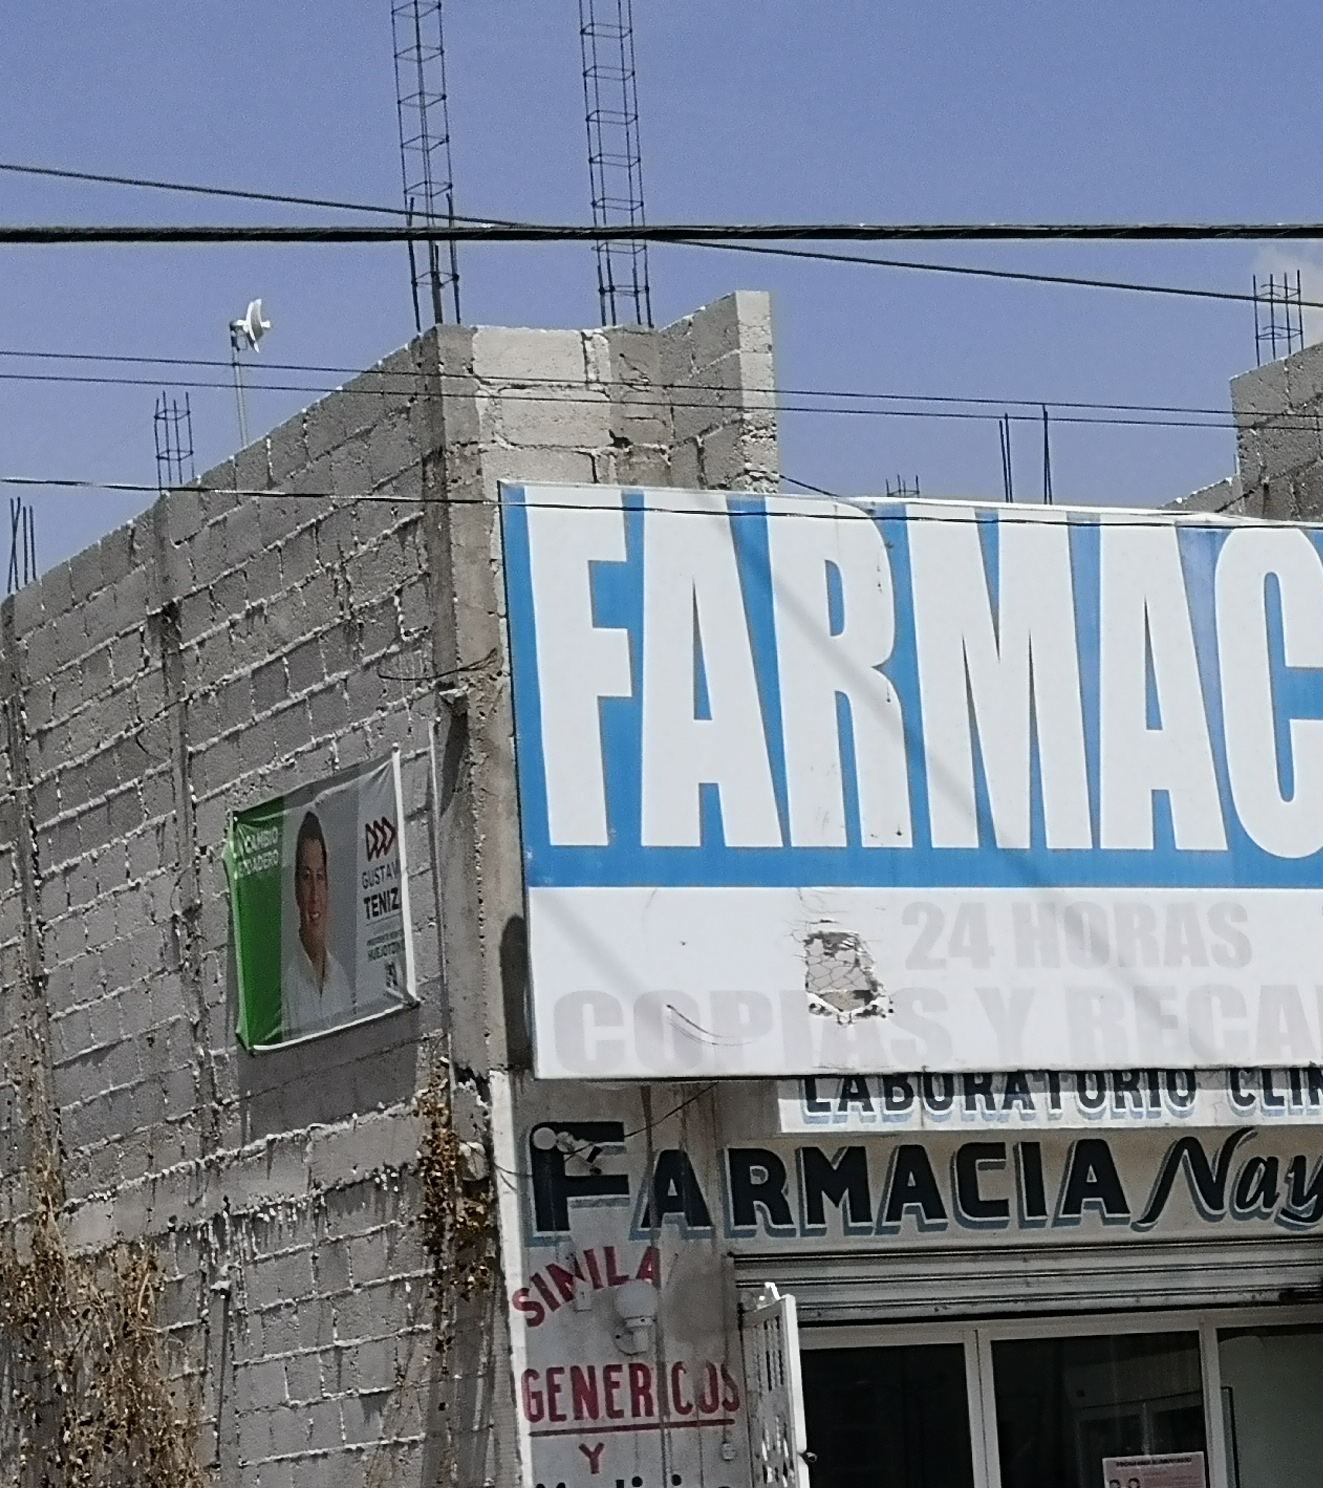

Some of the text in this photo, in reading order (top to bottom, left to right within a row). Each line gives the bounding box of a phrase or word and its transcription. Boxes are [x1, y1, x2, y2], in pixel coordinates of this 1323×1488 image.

[901, 900, 1254, 971] 24 HORAS
[553, 986, 954, 1074] COPIAS
[974, 986, 1037, 1070] Y
[528, 1120, 1131, 1240] FARMACIA
[578, 1441, 605, 1475] Y
